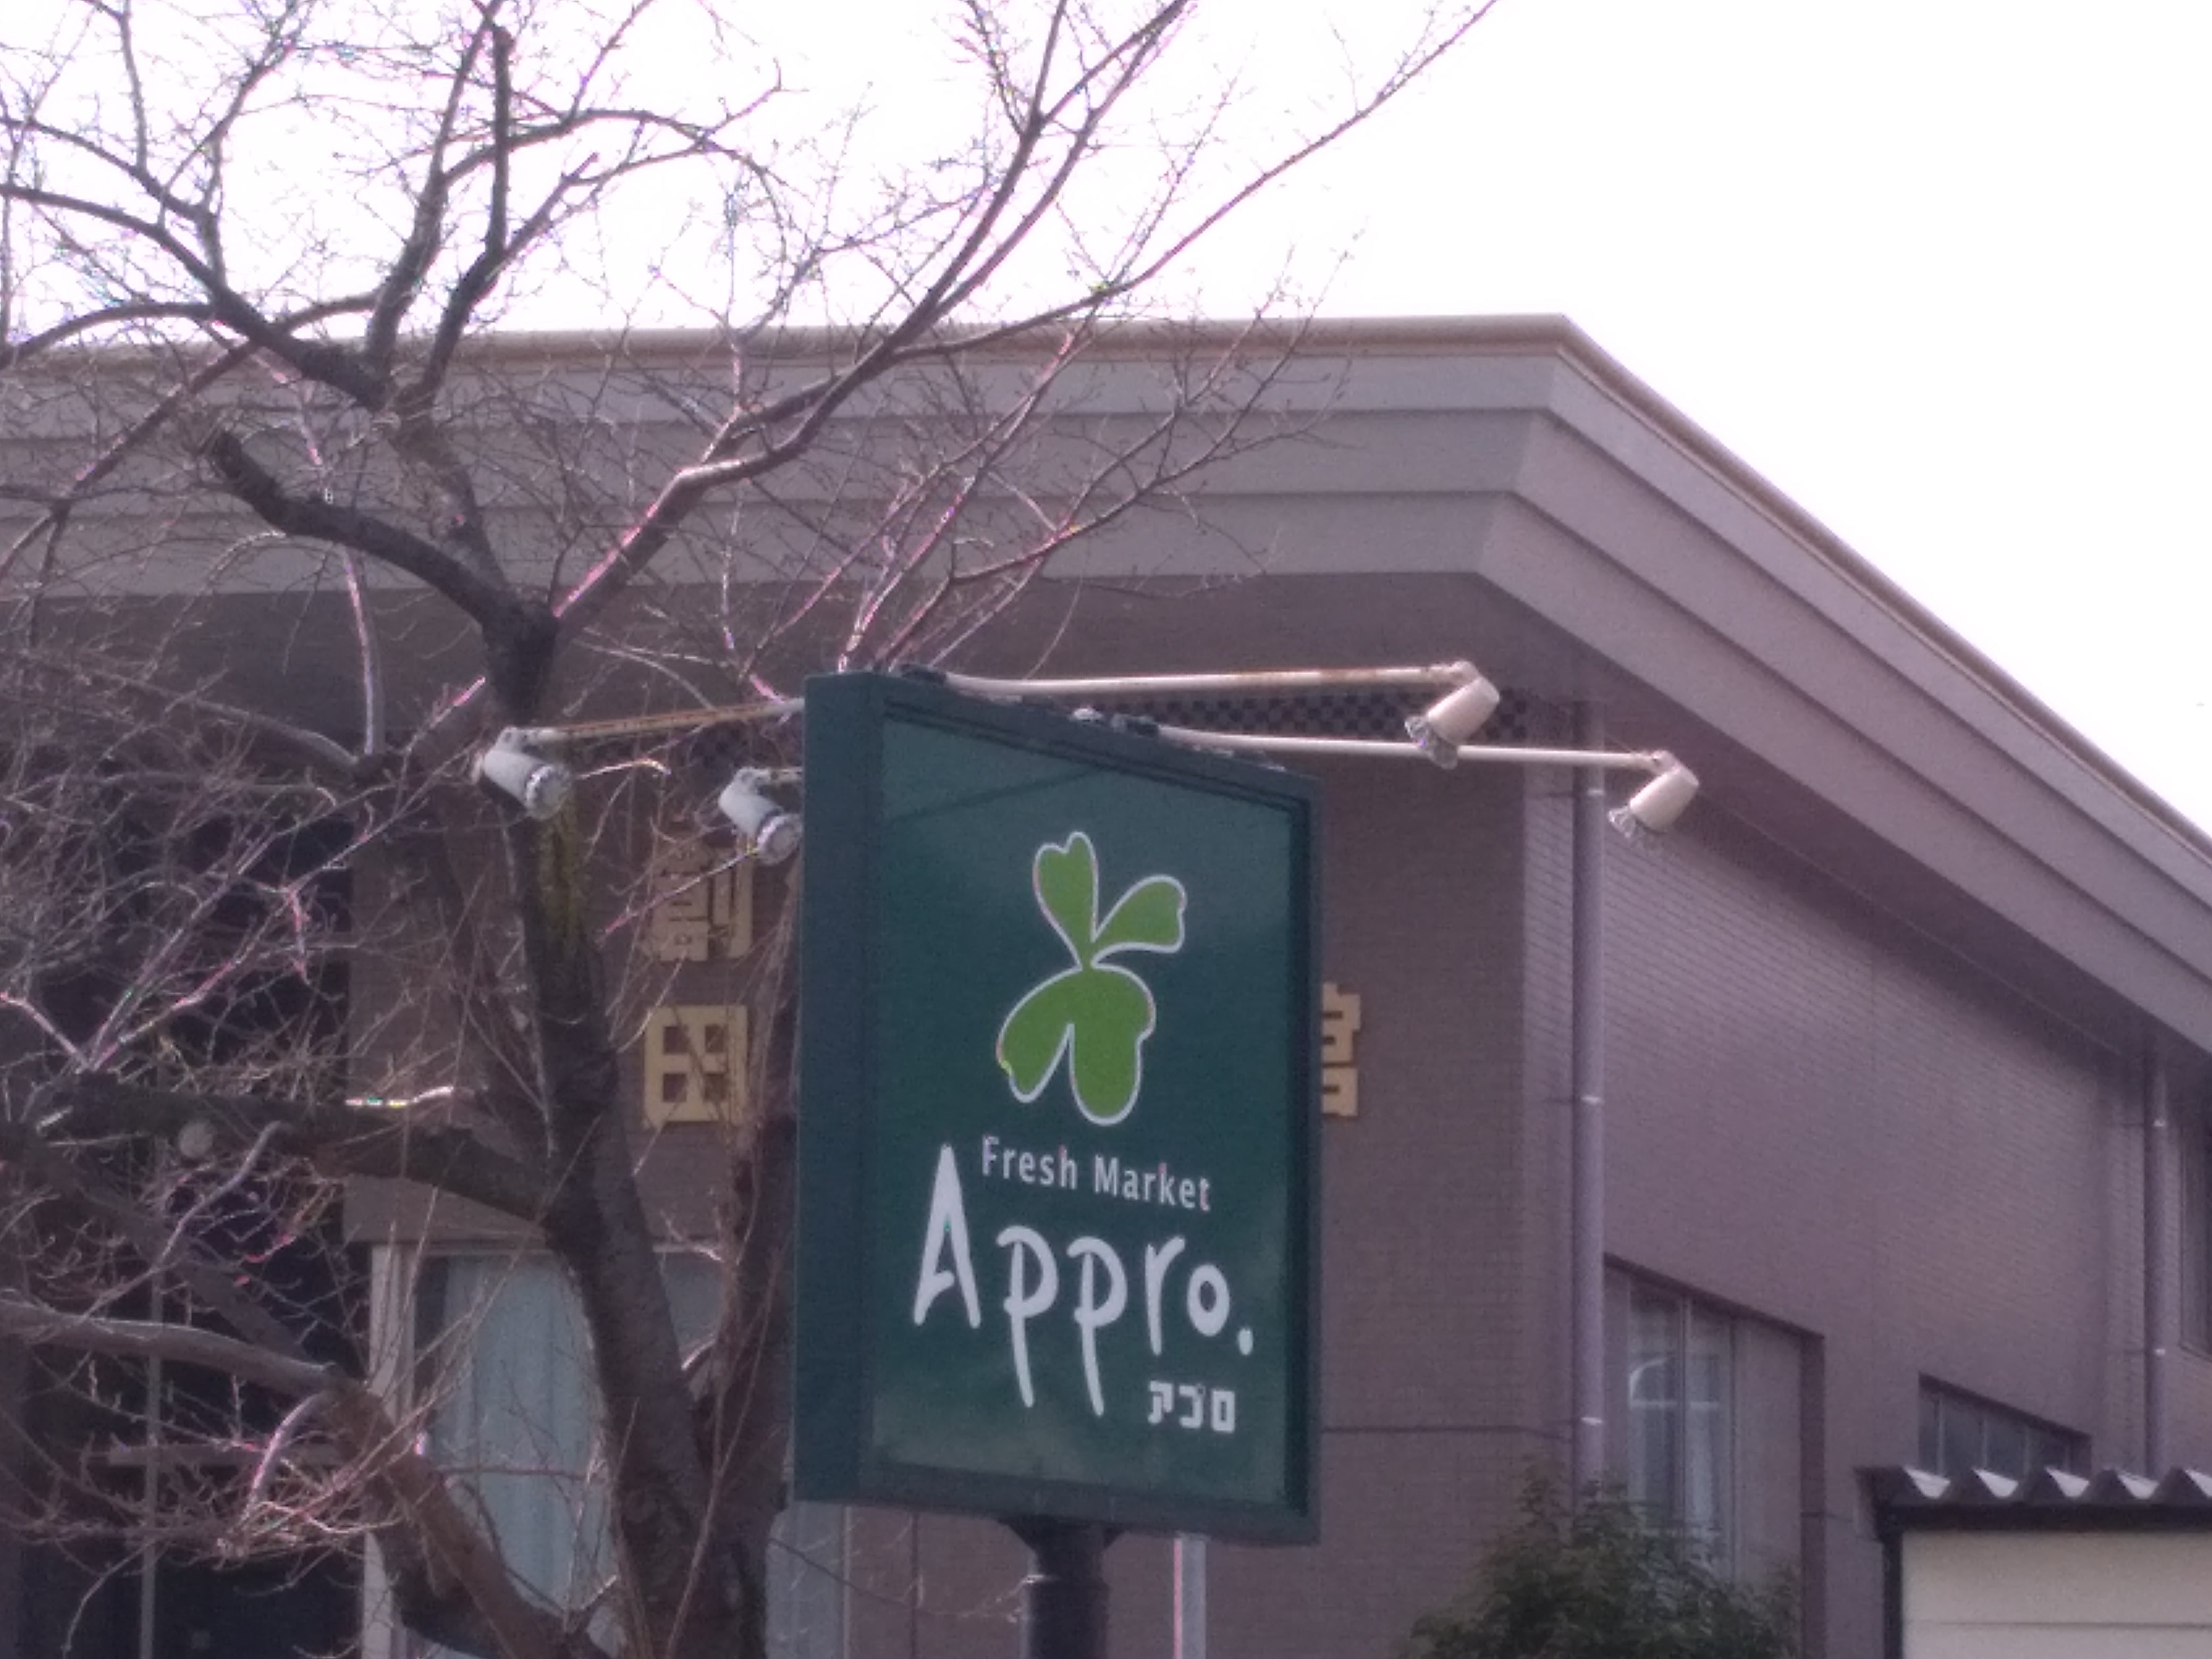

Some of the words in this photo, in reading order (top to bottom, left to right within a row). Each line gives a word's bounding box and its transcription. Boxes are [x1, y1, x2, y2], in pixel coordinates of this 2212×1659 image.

[643, 1004, 749, 1123] 田
[981, 1134, 1078, 1190] Fresh
[1093, 1153, 1211, 1212] Market
[913, 1143, 1254, 1417] Appro.
[1147, 1379, 1236, 1433] アプロ
